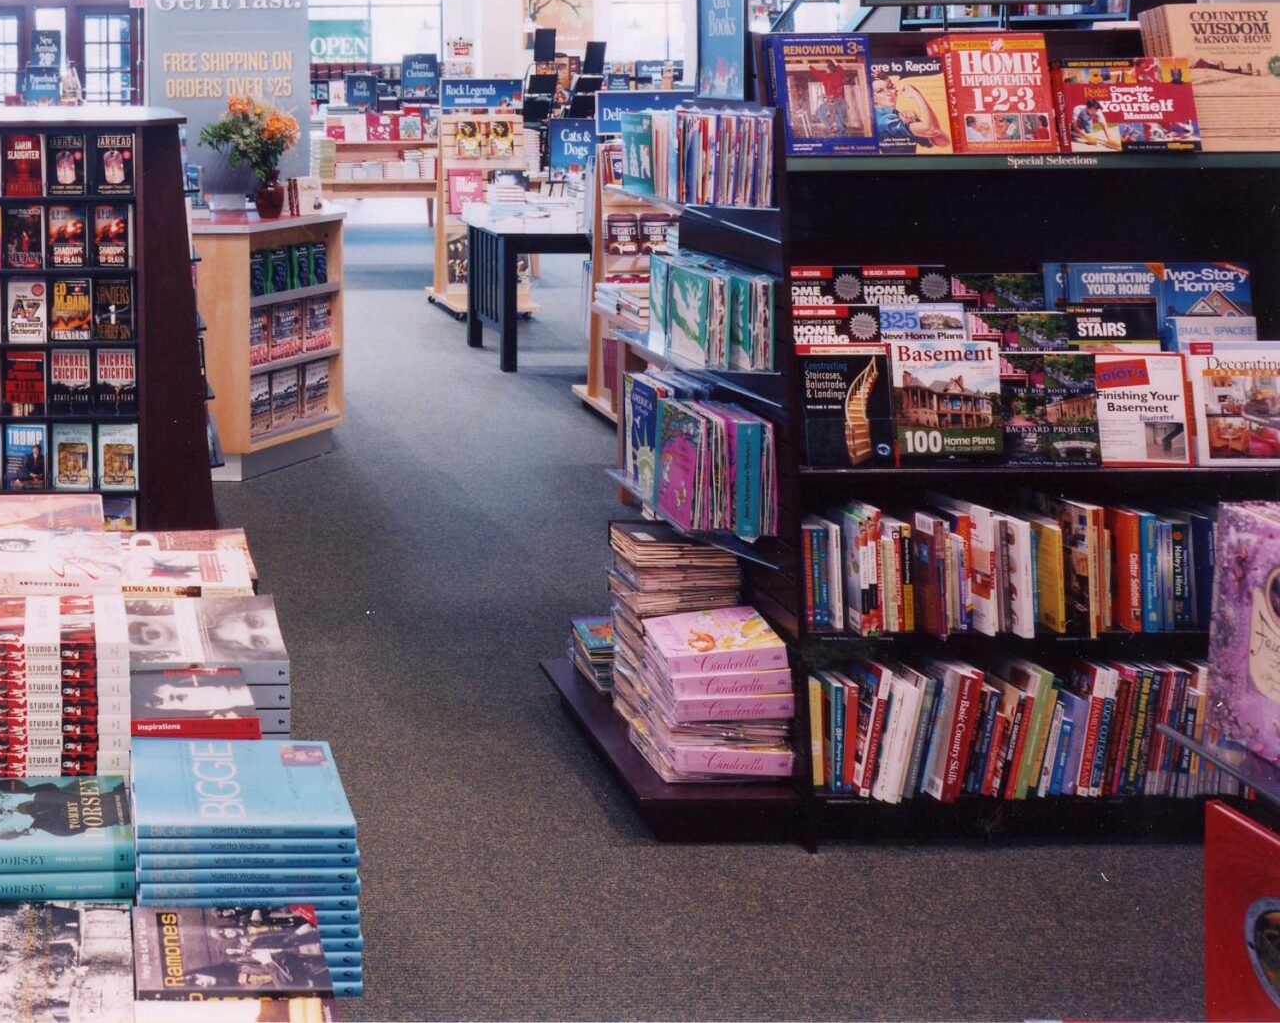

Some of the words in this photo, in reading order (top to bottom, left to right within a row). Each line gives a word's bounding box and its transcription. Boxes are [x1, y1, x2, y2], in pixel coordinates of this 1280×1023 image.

[708, 9, 736, 37] Books
[1189, 11, 1269, 22] COUNTRY
[1190, 22, 1270, 35] WISDOM
[310, 37, 369, 55] OPEN
[783, 45, 844, 55] RENOVATION
[162, 53, 197, 73] FREE
[201, 52, 266, 73] SHIPPING
[269, 51, 293, 73] ON
[411, 62, 429, 71] Merry
[871, 62, 890, 72] are
[891, 62, 903, 72] to
[905, 60, 941, 74] Repair
[958, 50, 1041, 75] HOME
[165, 78, 221, 98] ORDERS
[226, 77, 263, 98] OVER
[267, 77, 293, 98] $25
[961, 74, 1042, 87] IMPROVEMENT
[445, 83, 465, 95] Rock
[465, 84, 496, 98] Legends
[1110, 86, 1153, 94] Complete
[972, 87, 1036, 112] 1-2-3
[1110, 93, 1155, 103] Do-It-
[1098, 99, 1174, 113] Yourself
[1124, 112, 1163, 120] Manual
[97, 135, 132, 147] JARHEAD
[560, 129, 582, 143] Cats
[583, 129, 591, 143] &
[563, 143, 589, 159] Dogs
[1007, 155, 1043, 169] Special
[1046, 155, 1098, 166] Selections
[1081, 273, 1155, 284] CONTRACTING
[1163, 269, 1247, 283] Two-Story
[863, 285, 906, 295] HOME
[1087, 284, 1116, 295] YOUR
[1119, 284, 1150, 295] HOME
[1174, 281, 1236, 292] Homes
[864, 294, 920, 304] WIRING
[879, 311, 919, 329] 325
[10, 328, 42, 336] Dictionary
[793, 325, 836, 335] HOME
[880, 332, 904, 340] New
[906, 332, 935, 340] Home
[937, 332, 963, 340] Plans
[1077, 323, 1127, 337] STAIRS
[1178, 327, 1210, 336] SMALL
[1214, 326, 1254, 335] SPACES
[53, 354, 88, 366] MICHAEL
[898, 346, 993, 362] Basement
[804, 361, 848, 372] Constructing
[53, 368, 88, 380] CRICHTON
[804, 371, 843, 380] Staircases,
[805, 381, 847, 389] Balustrades
[806, 389, 812, 398] &
[814, 389, 846, 399] Landings
[1096, 390, 1148, 403] Finishing
[1149, 391, 1180, 401] Your
[1107, 403, 1169, 413] Basement
[1053, 426, 1095, 434] PROJECTS
[8, 430, 41, 446] TRUMP
[905, 431, 942, 453] 100
[943, 437, 970, 445] Home
[972, 437, 996, 445] Plans
[1129, 553, 1138, 576] Clutter
[1174, 546, 1182, 572] Haley's
[146, 585, 163, 593] AND
[1130, 578, 1139, 606] Solution
[1175, 575, 1183, 596] Hints
[694, 656, 760, 674] Cinderella
[958, 699, 970, 722] Basic
[1103, 698, 1114, 723] COZY
[949, 723, 965, 760] Country
[1094, 725, 1109, 765] COTTAGE
[700, 755, 766, 772] Cinderella
[947, 759, 959, 785] Skills
[190, 742, 247, 818] BIGGIE
[79, 778, 105, 838] DORSEY
[67, 801, 81, 830] TOMMY
[212, 826, 238, 834] Voletta
[240, 826, 272, 834] Wallace
[214, 857, 241, 865] Voletta
[243, 857, 274, 865] Wallace
[163, 913, 179, 987] Ramones
